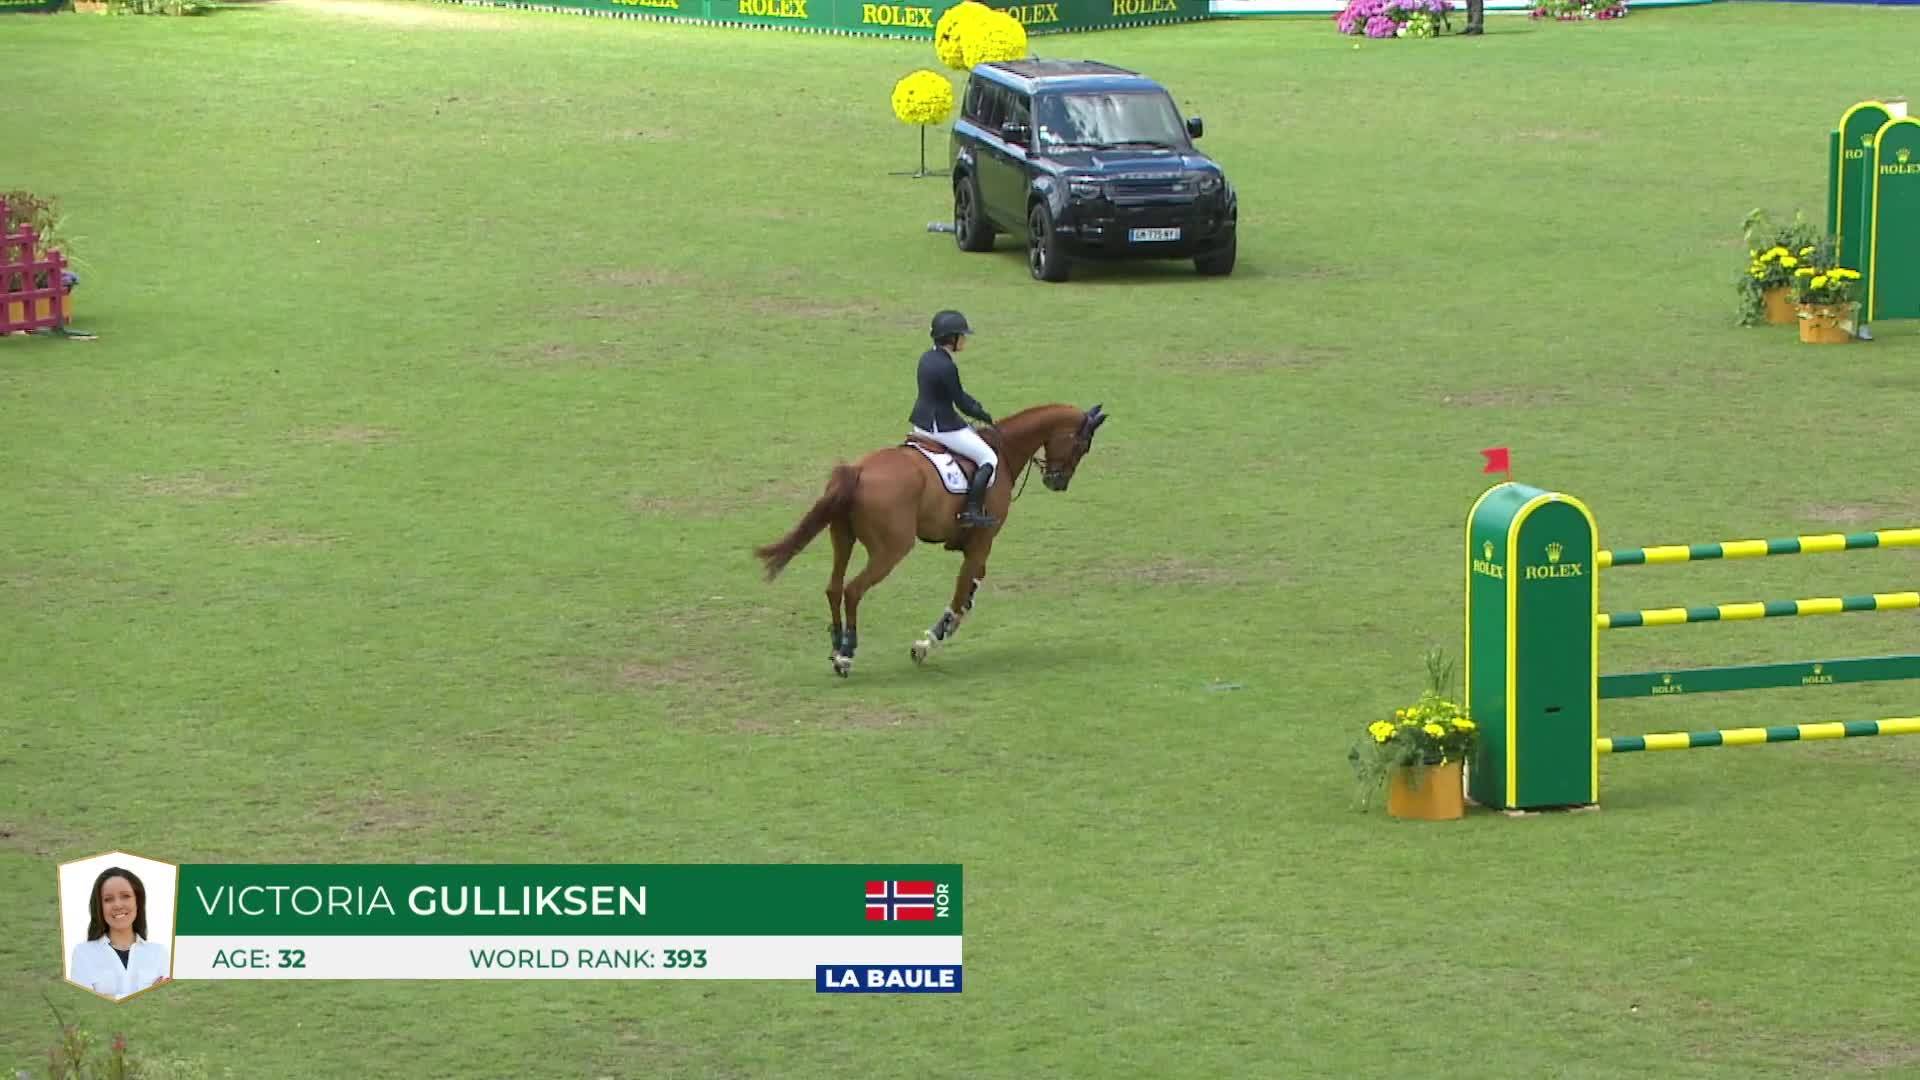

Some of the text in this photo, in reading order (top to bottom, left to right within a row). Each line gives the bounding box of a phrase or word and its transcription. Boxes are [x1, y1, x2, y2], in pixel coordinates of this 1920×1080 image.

[739, 0, 808, 18] ROLEX
[863, 4, 934, 27] ROLEX
[1008, 3, 1059, 24] OLEX
[1845, 149, 1863, 159] RO
[1473, 559, 1504, 580] ROLEX
[1526, 563, 1582, 580] ROLEX
